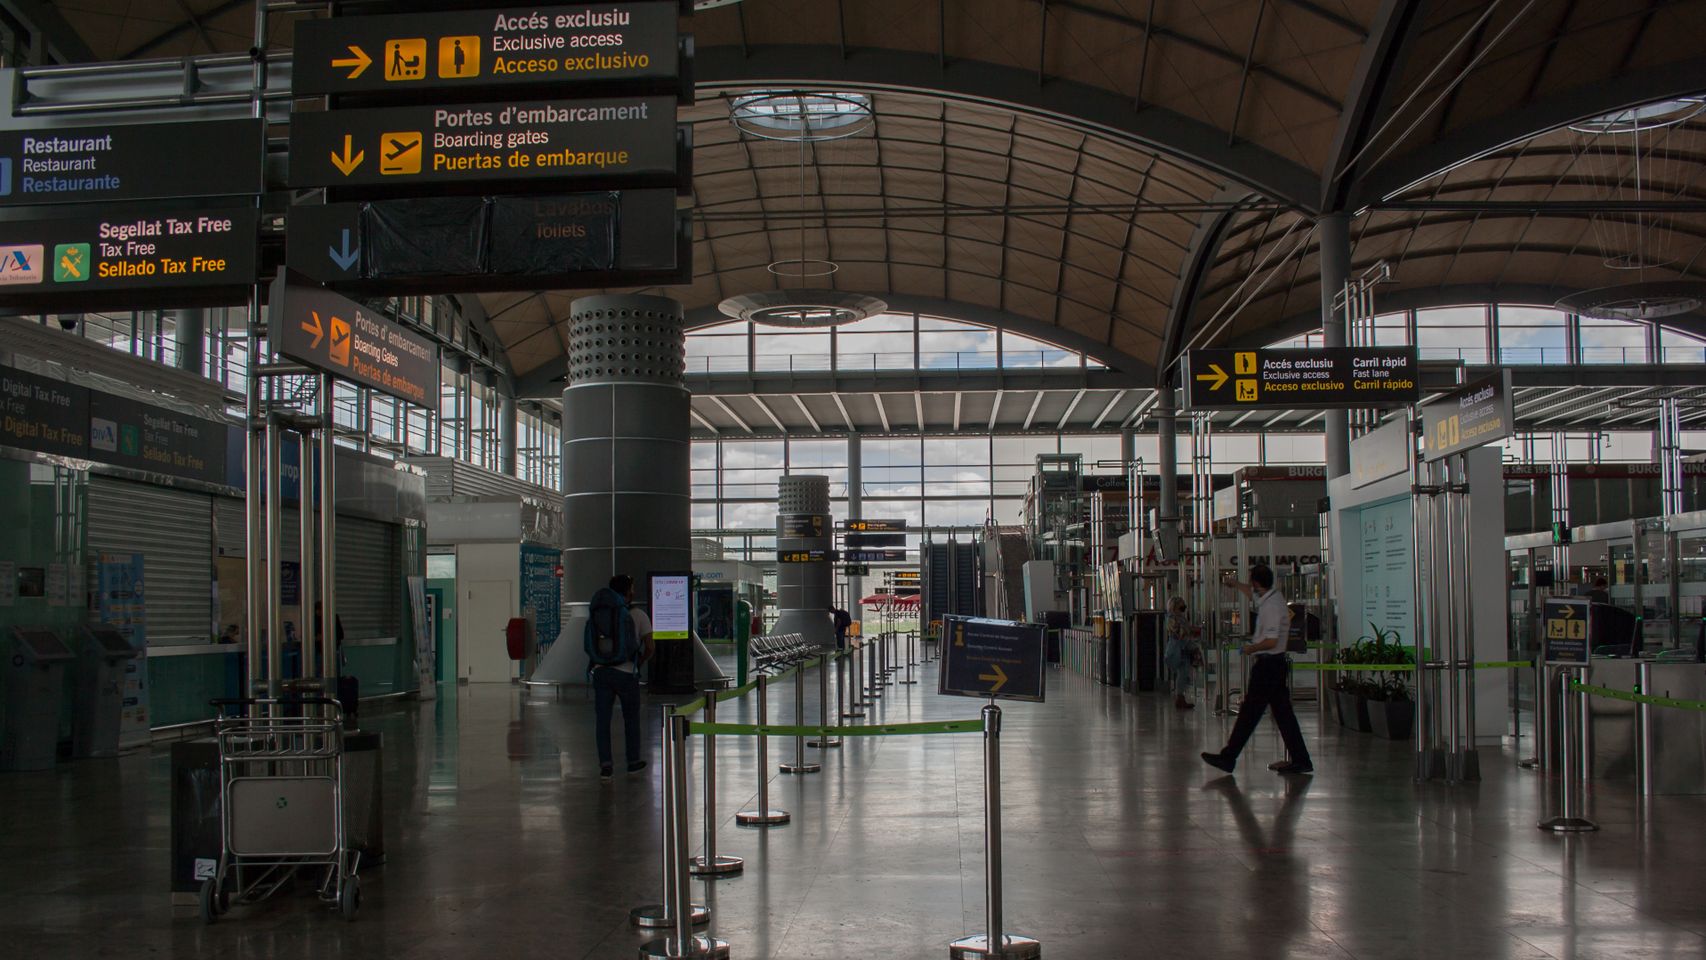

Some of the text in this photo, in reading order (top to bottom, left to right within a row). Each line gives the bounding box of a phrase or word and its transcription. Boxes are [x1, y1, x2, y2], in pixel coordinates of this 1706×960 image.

[494, 9, 631, 32] Accés exclusiu
[493, 33, 623, 51] Exclusive access
[493, 53, 650, 74] Acceso exclusivo
[434, 102, 649, 127] Portes d'embarcament
[24, 134, 113, 154] Restaurant
[434, 130, 550, 149] Boarding gates
[23, 156, 96, 173] Restaurant
[433, 149, 629, 171] Puertas de embarque
[23, 173, 120, 193] Restaurante
[99, 216, 232, 242] Segellat Tax Free
[536, 223, 587, 238] Toilets
[99, 241, 156, 258] Tax Free
[98, 256, 227, 279] Sellado Tax Free
[355, 311, 380, 337] Portes
[354, 334, 399, 368] Boarding Gates
[1263, 356, 1334, 369] Accés exclusiu
[1352, 356, 1407, 370] Carril ràpid
[353, 356, 425, 400] Puertas de embarque
[1263, 370, 1330, 380] Exclusive access
[1352, 369, 1390, 378] Fast lane
[3, 377, 71, 407] Digital Tax Free
[1264, 380, 1345, 392] Acceso exclusivo
[1353, 379, 1414, 391] Carril rápido
[7, 397, 25, 415] Free
[5, 415, 83, 446] Digital Tax Free
[1288, 466, 1326, 477] BURG
[1627, 464, 1662, 475] BURG
